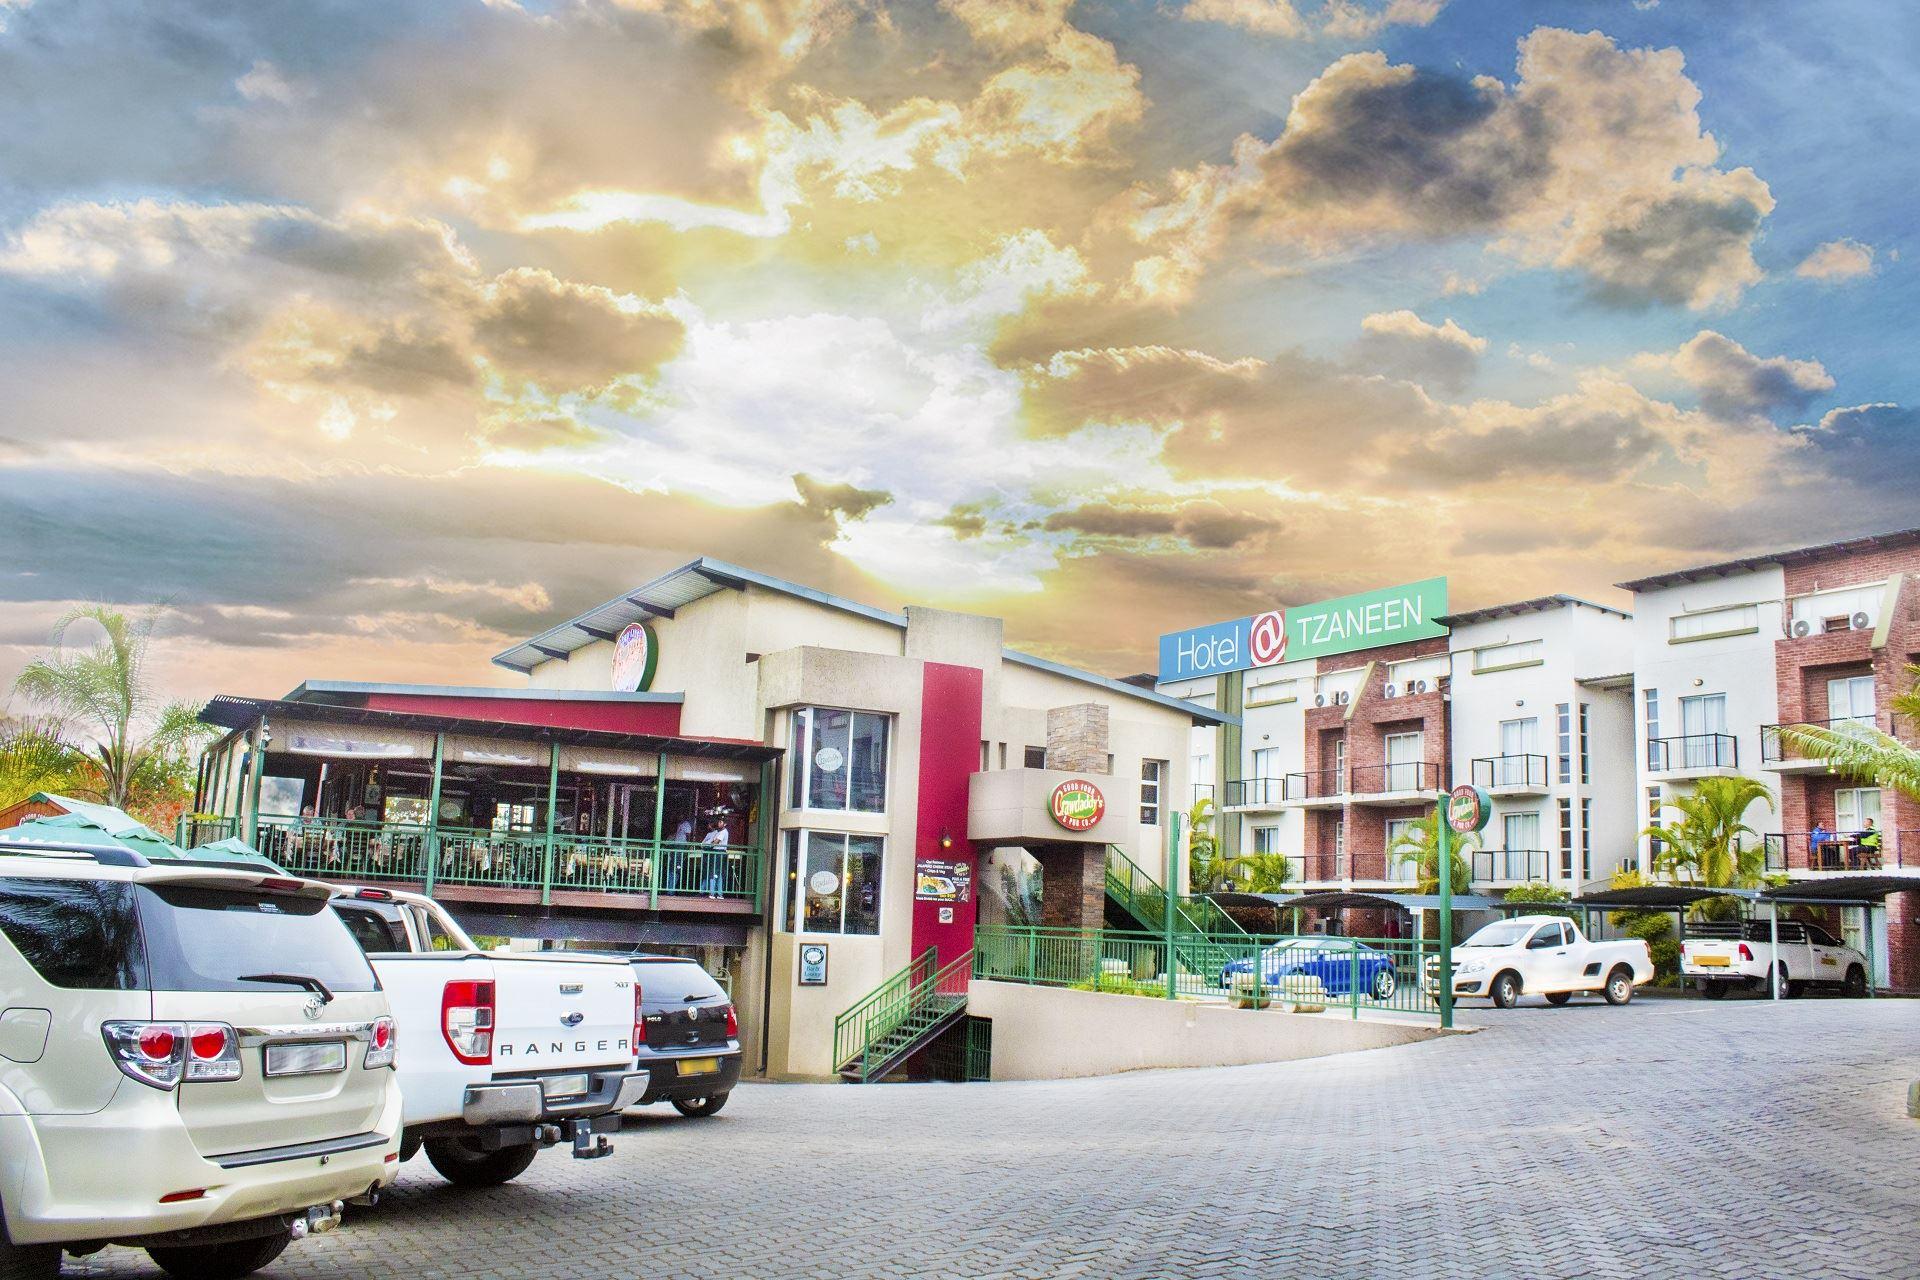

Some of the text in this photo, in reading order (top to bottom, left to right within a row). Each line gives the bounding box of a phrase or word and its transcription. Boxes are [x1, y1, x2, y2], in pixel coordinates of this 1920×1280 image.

[1178, 625, 1239, 673] Hotel
[1297, 595, 1422, 646] TZANEEN
[1063, 783, 1095, 796] GOOD FOOD
[1054, 790, 1104, 816] Crawdaddy's
[500, 1039, 628, 1056] RANGER
